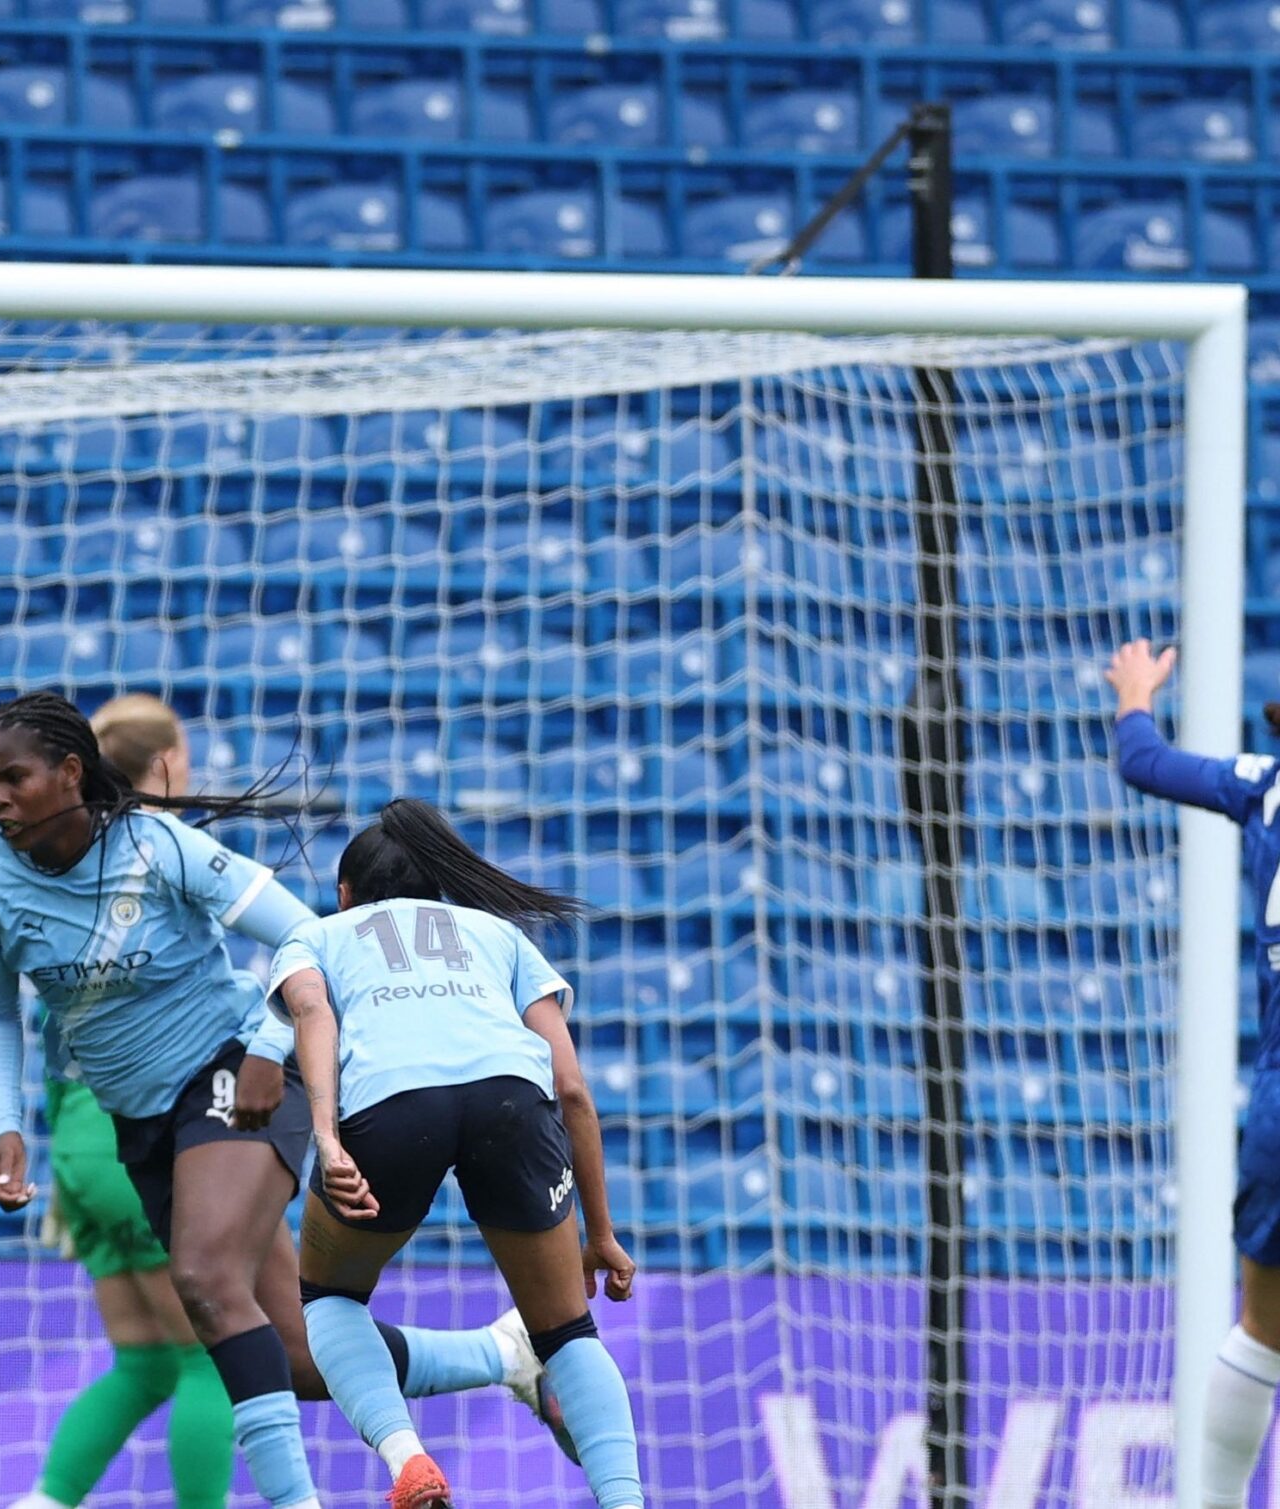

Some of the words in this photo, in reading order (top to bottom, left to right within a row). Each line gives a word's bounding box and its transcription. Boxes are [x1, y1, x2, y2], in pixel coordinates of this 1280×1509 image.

[354, 906, 473, 974] 14
[31, 949, 153, 982] ETIHAD
[371, 980, 488, 1007] Revolut
[212, 1069, 236, 1109] 9
